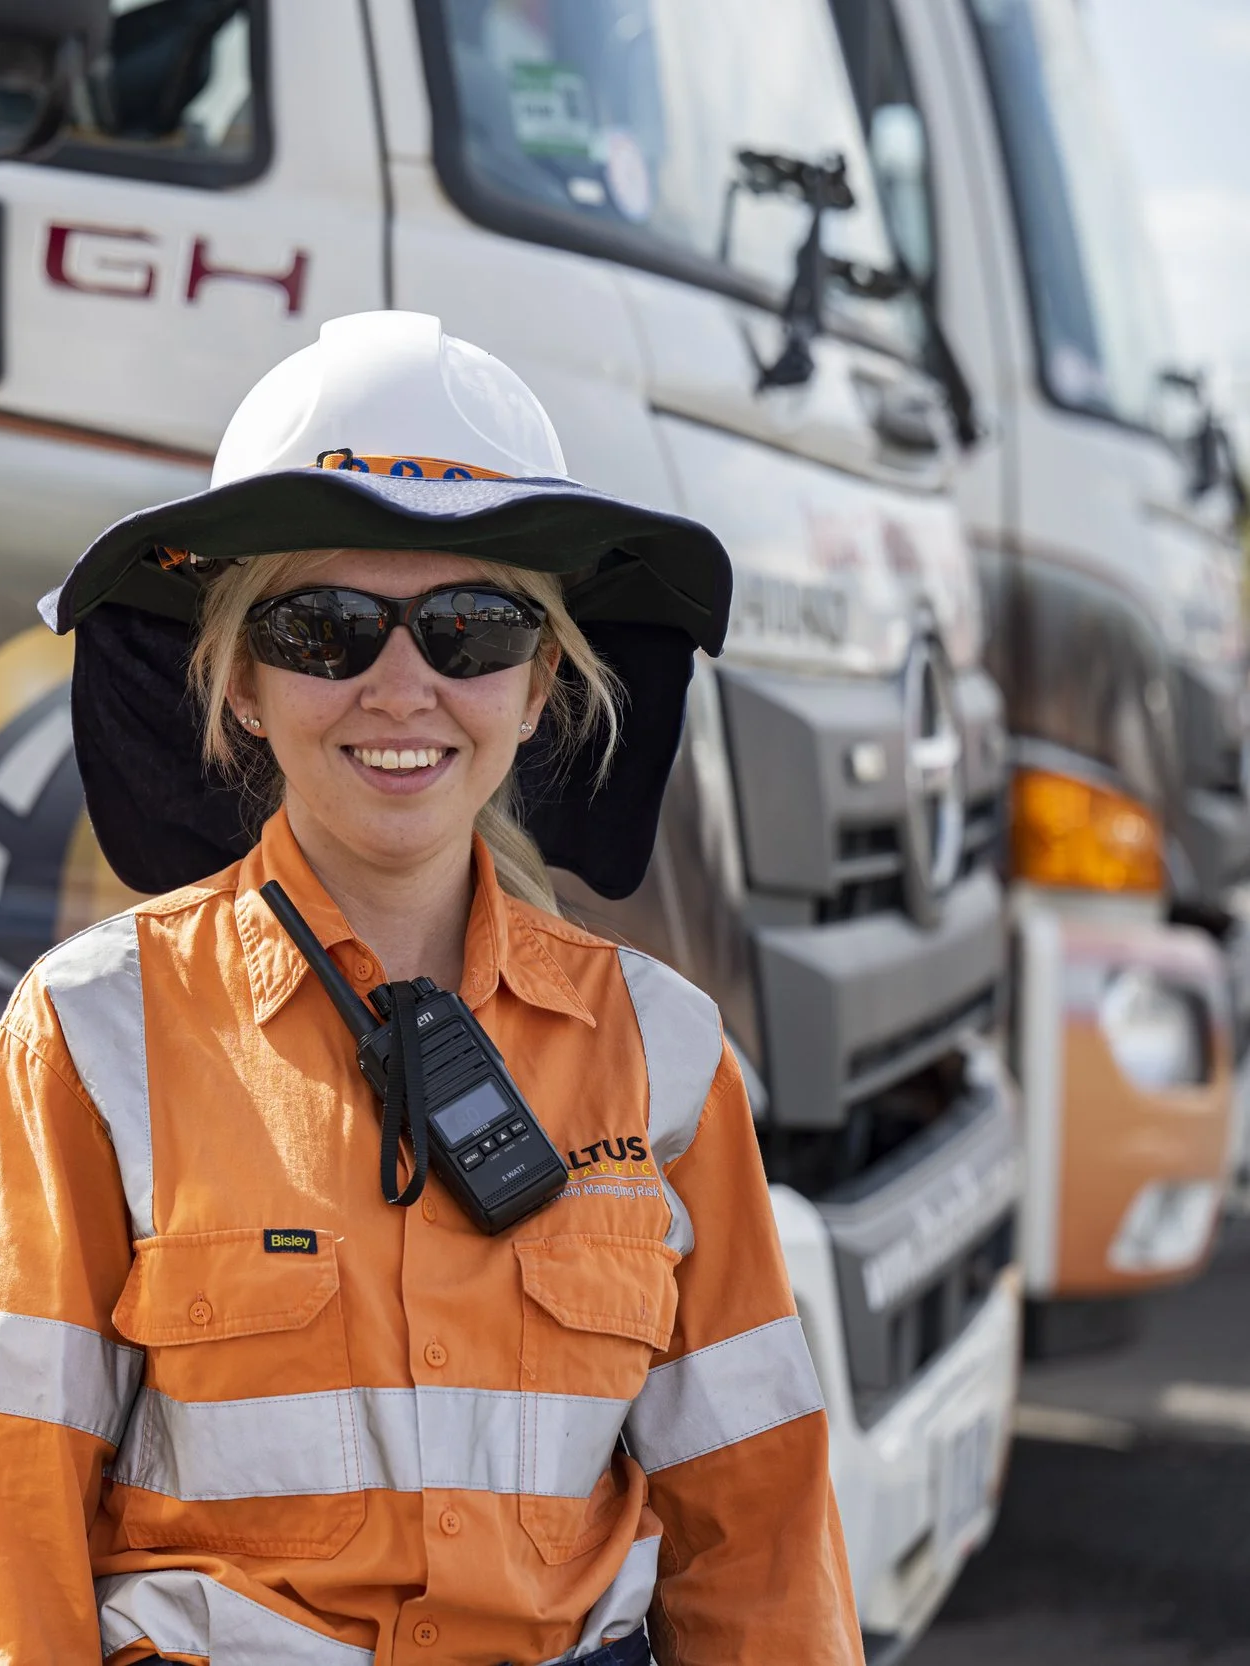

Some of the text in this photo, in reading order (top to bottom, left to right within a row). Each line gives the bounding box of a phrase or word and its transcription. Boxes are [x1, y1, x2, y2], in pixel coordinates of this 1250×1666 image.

[45, 221, 310, 318] GH
[416, 1011, 435, 1027] en
[464, 1152, 480, 1165] MENU
[567, 1136, 648, 1170] LTUS
[501, 1163, 527, 1183] 5 WATT
[567, 1162, 653, 1181] RAFFIC
[584, 1181, 636, 1200] Managing
[636, 1181, 660, 1200] Risk
[271, 1234, 310, 1249] Bisley
